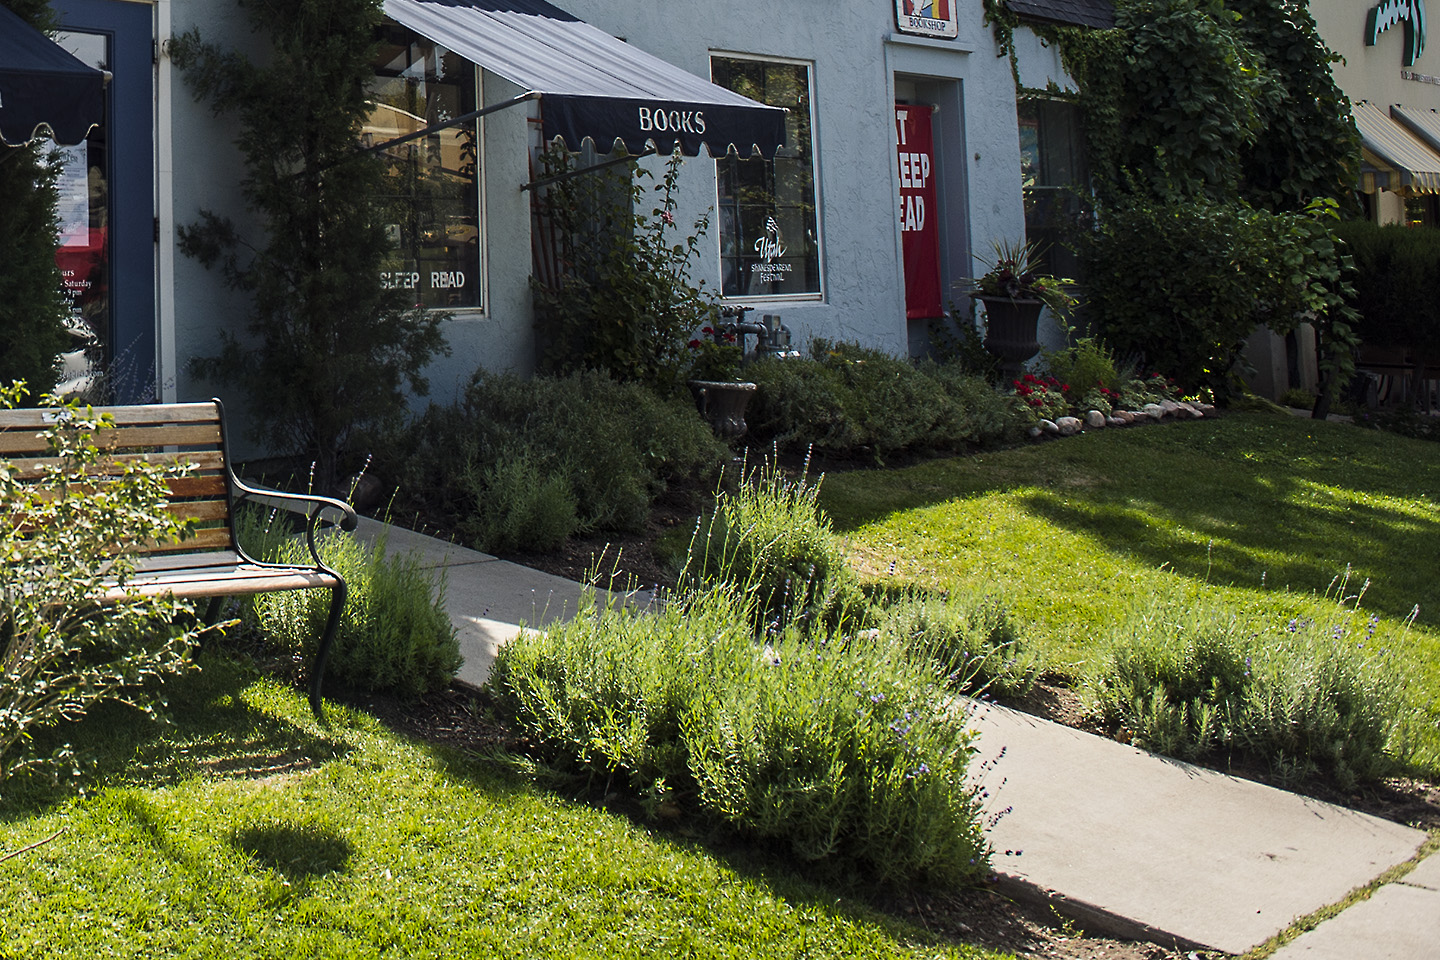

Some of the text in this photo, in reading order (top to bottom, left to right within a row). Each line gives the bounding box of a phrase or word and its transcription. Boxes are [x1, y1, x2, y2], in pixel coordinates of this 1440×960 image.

[909, 17, 946, 32] BOOKSHOP
[638, 107, 706, 135] BOOKS
[899, 152, 930, 188] EEP
[754, 236, 788, 263] Utah
[64, 279, 92, 289] Saturday
[431, 271, 465, 289] READ
